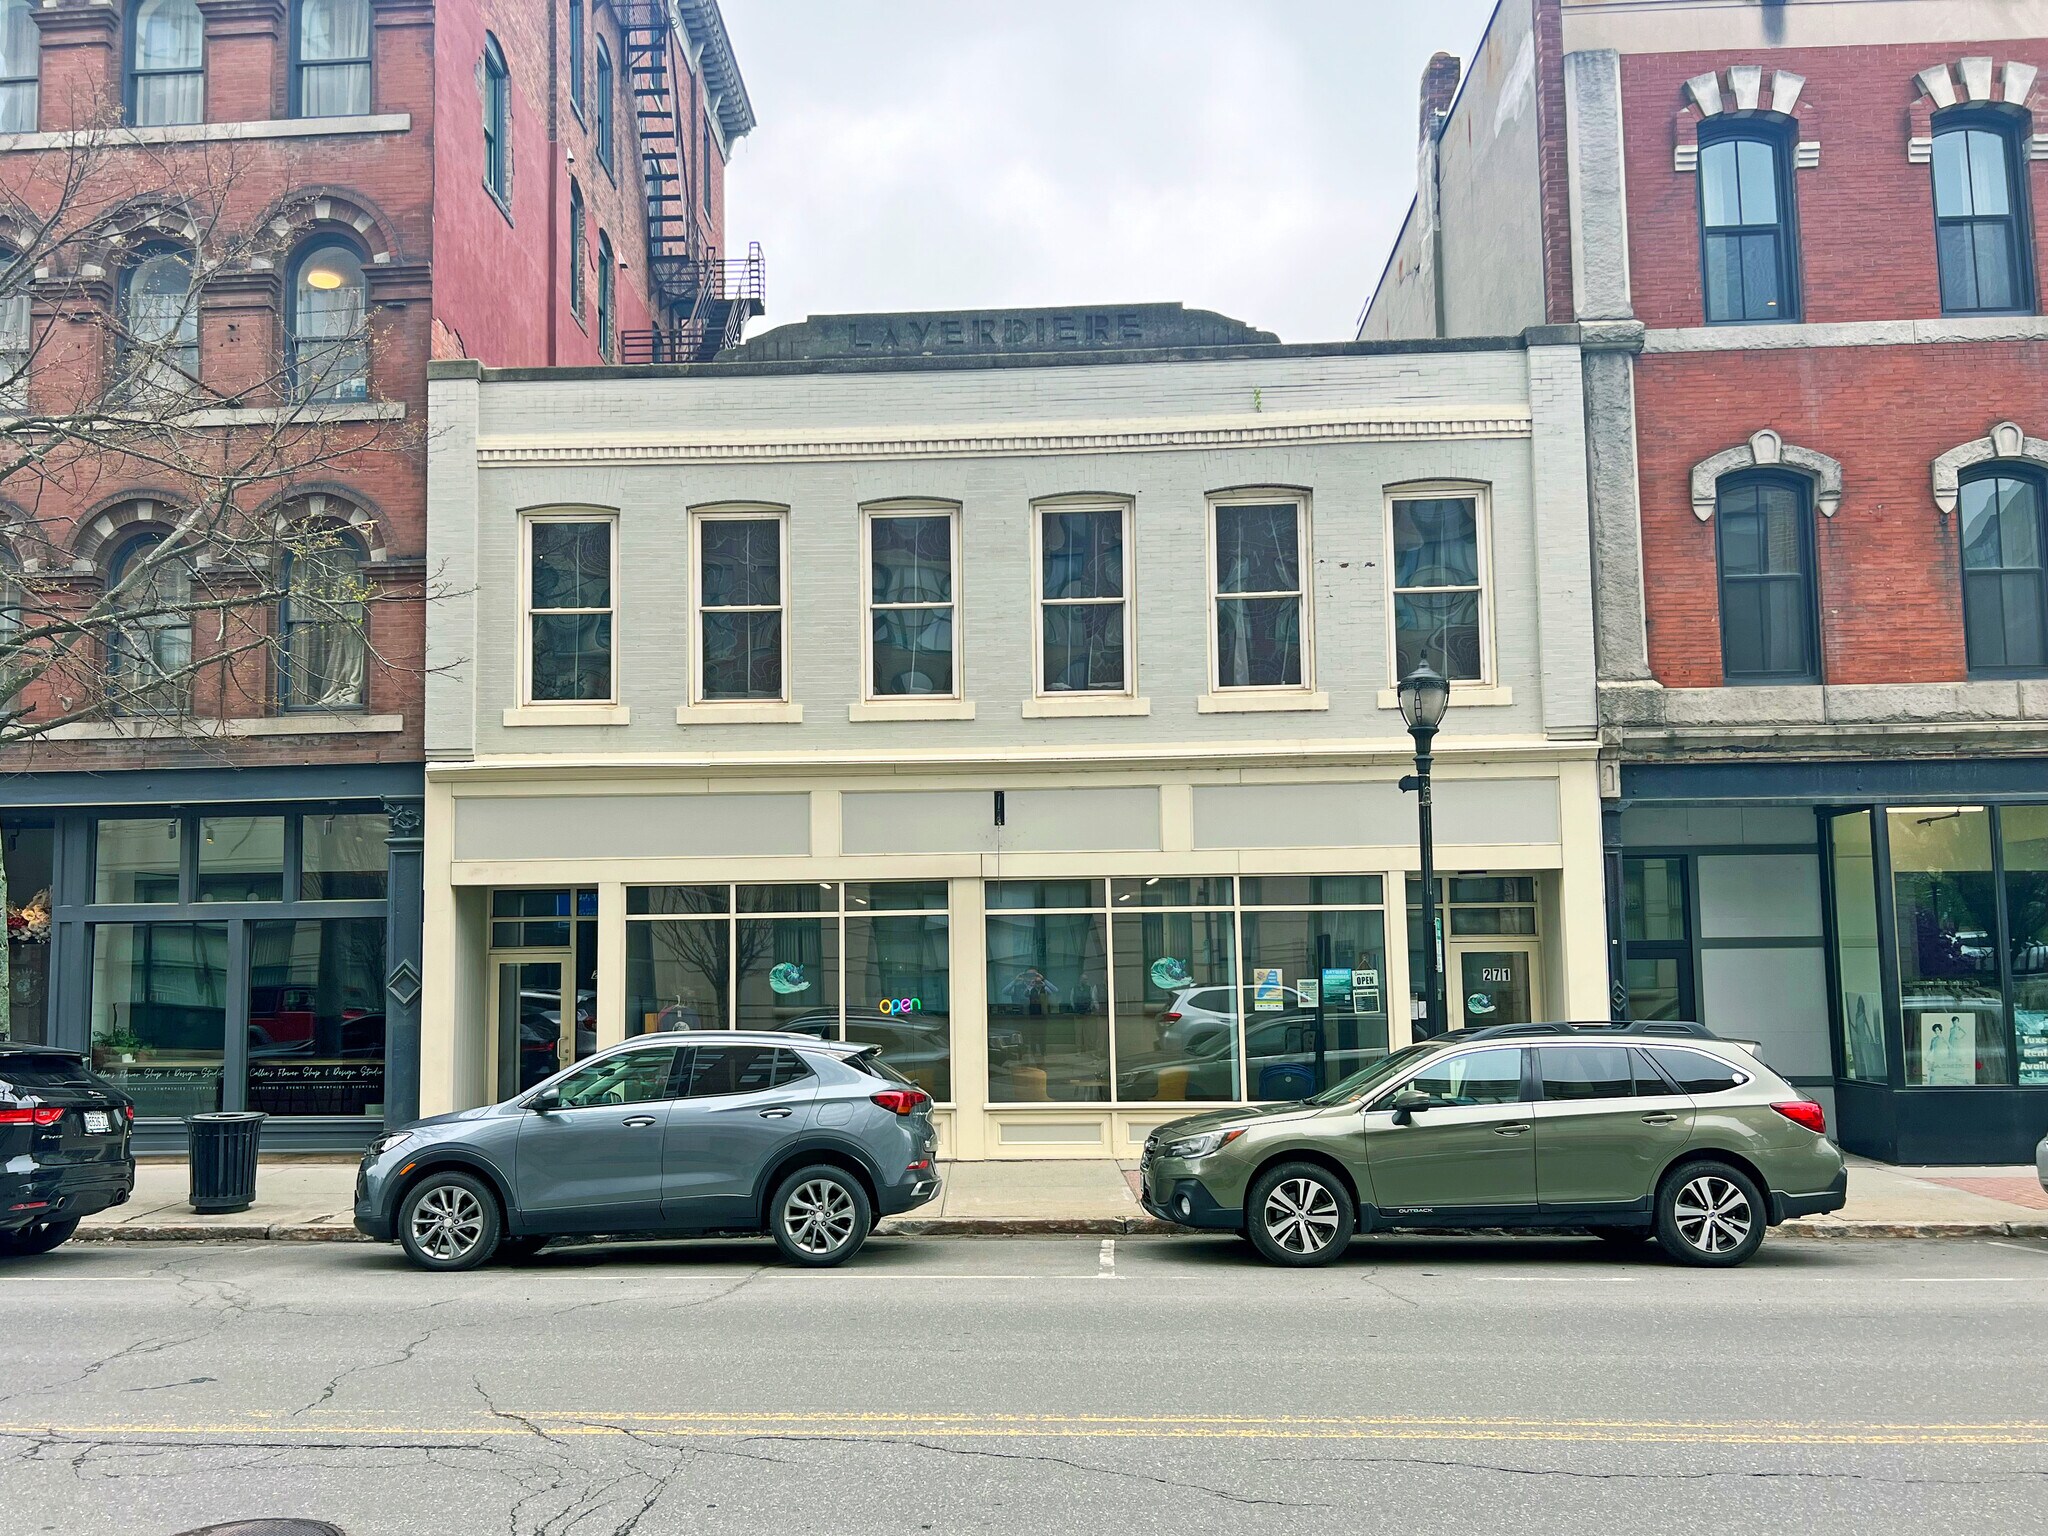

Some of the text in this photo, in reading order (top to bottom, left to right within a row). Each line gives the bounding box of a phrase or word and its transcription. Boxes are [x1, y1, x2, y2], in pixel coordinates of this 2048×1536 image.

[848, 313, 1143, 349] LAVERDIERE
[1356, 976, 1375, 985] OPEN
[1483, 969, 1510, 981] 271
[879, 997, 922, 1016] open
[143, 1067, 162, 1080] Shop
[174, 1068, 197, 1081] Design
[302, 1066, 320, 1079] Shop
[333, 1066, 356, 1079] Design
[360, 1065, 383, 1077] Studio
